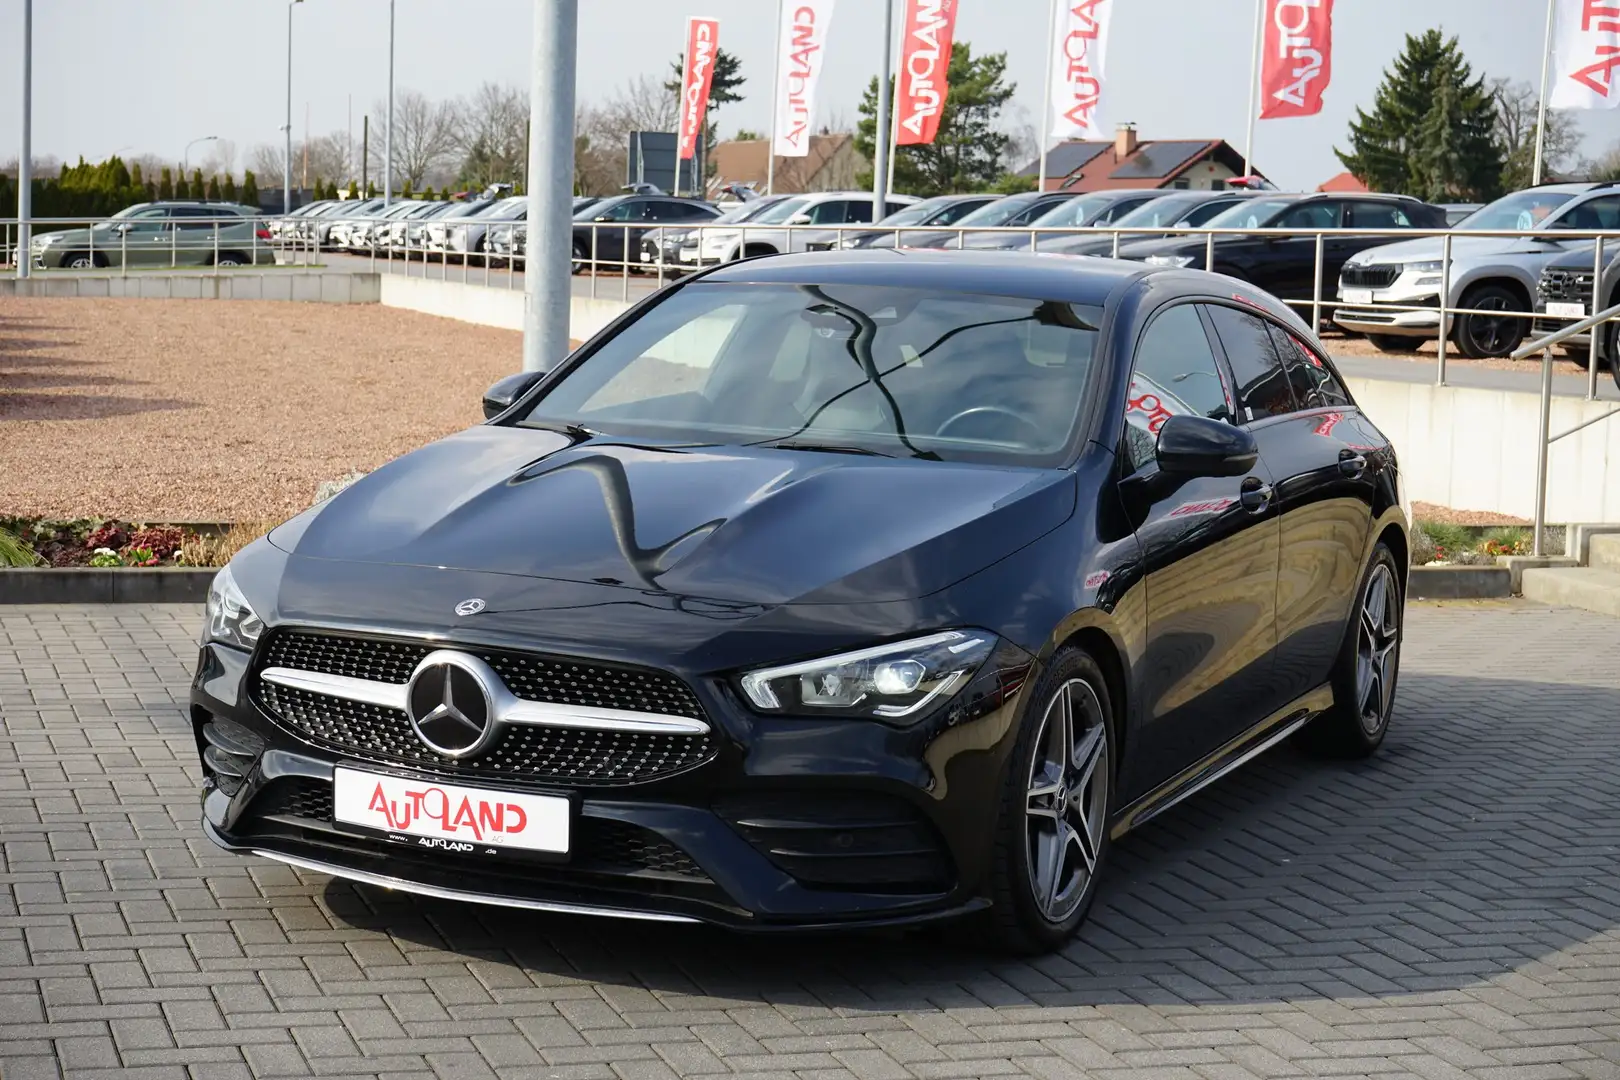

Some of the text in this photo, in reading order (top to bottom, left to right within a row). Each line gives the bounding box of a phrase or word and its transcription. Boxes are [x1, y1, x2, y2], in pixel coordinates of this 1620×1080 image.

[784, 6, 820, 148] AUTOLAND
[368, 782, 527, 840] AUTOLAND
[418, 837, 474, 852] AUTOLAND
